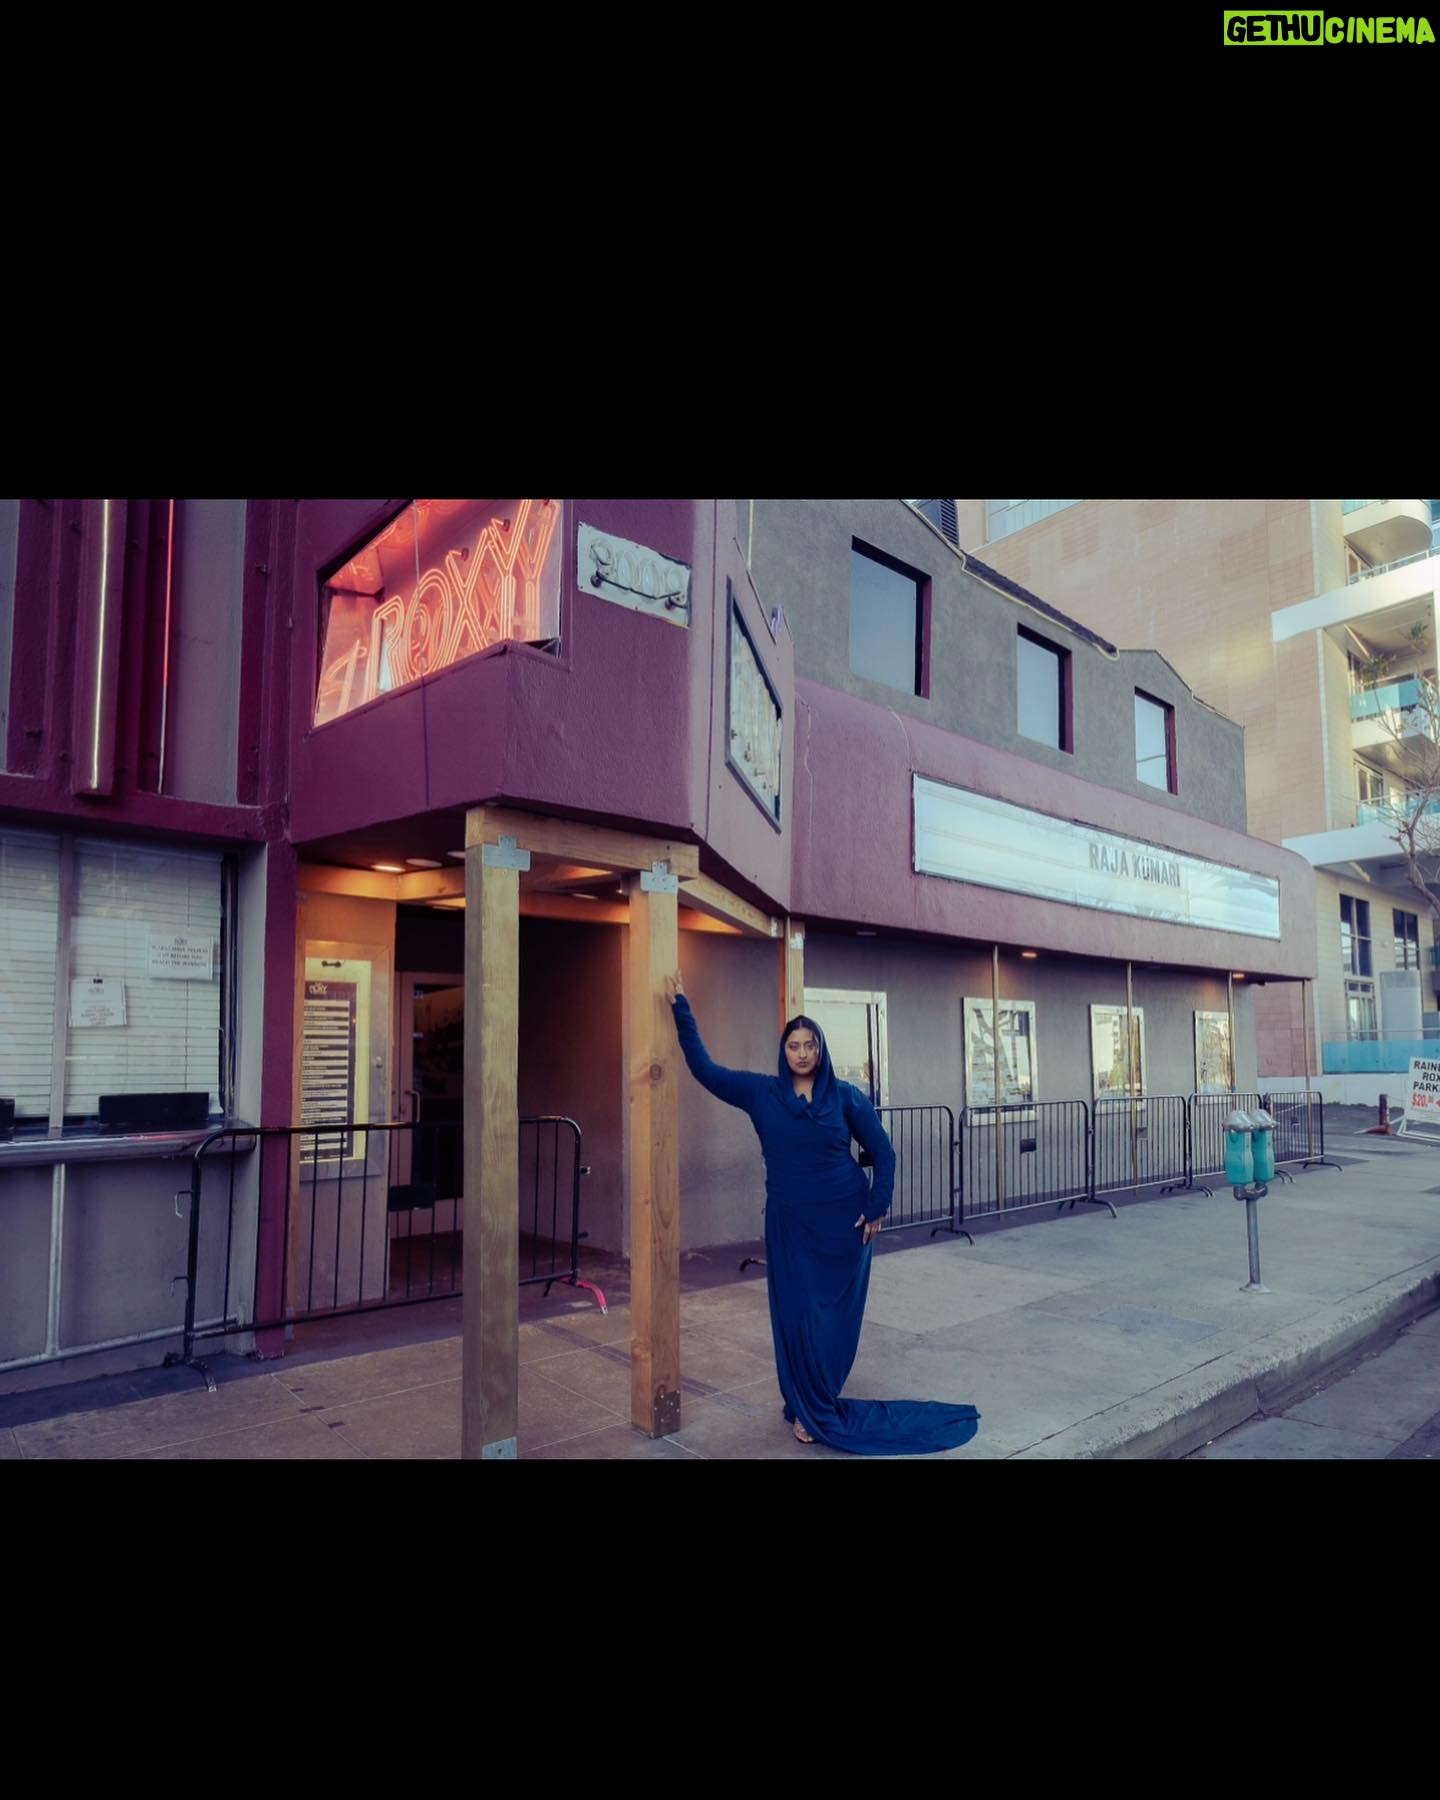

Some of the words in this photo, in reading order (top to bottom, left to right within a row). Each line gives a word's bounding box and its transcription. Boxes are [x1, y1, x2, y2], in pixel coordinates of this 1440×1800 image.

[362, 499, 533, 702] ROXY
[1088, 842, 1129, 877] RAJA
[1132, 854, 1181, 888] KUMARI
